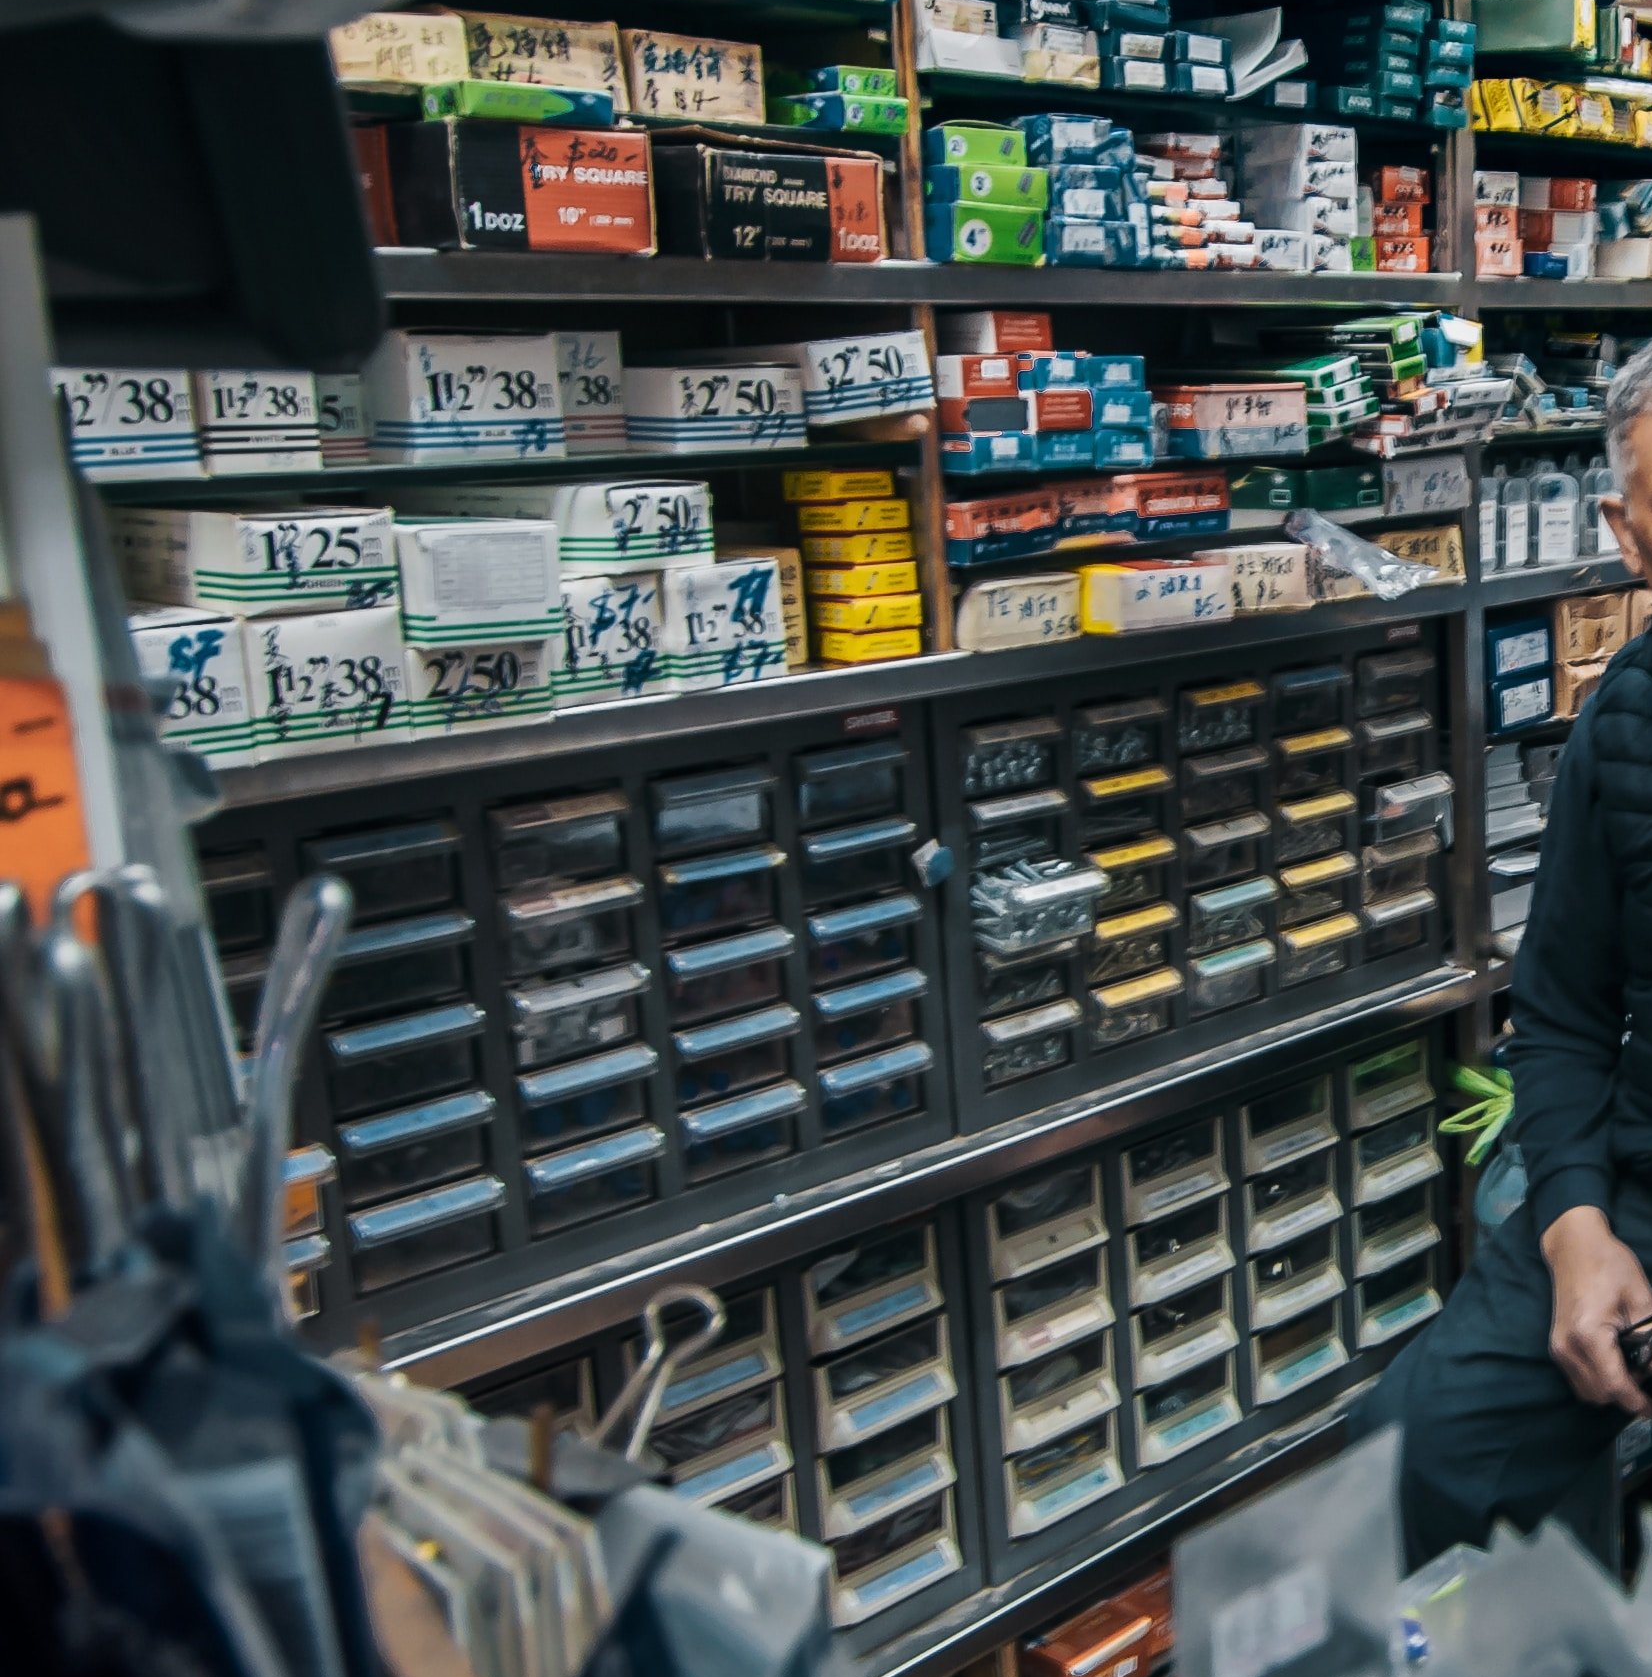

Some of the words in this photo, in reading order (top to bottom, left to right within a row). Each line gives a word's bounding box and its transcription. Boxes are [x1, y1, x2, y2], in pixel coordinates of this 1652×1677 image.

[573, 164, 649, 186] SQUARE
[722, 185, 756, 204] TRY
[762, 188, 829, 209] SQUARE
